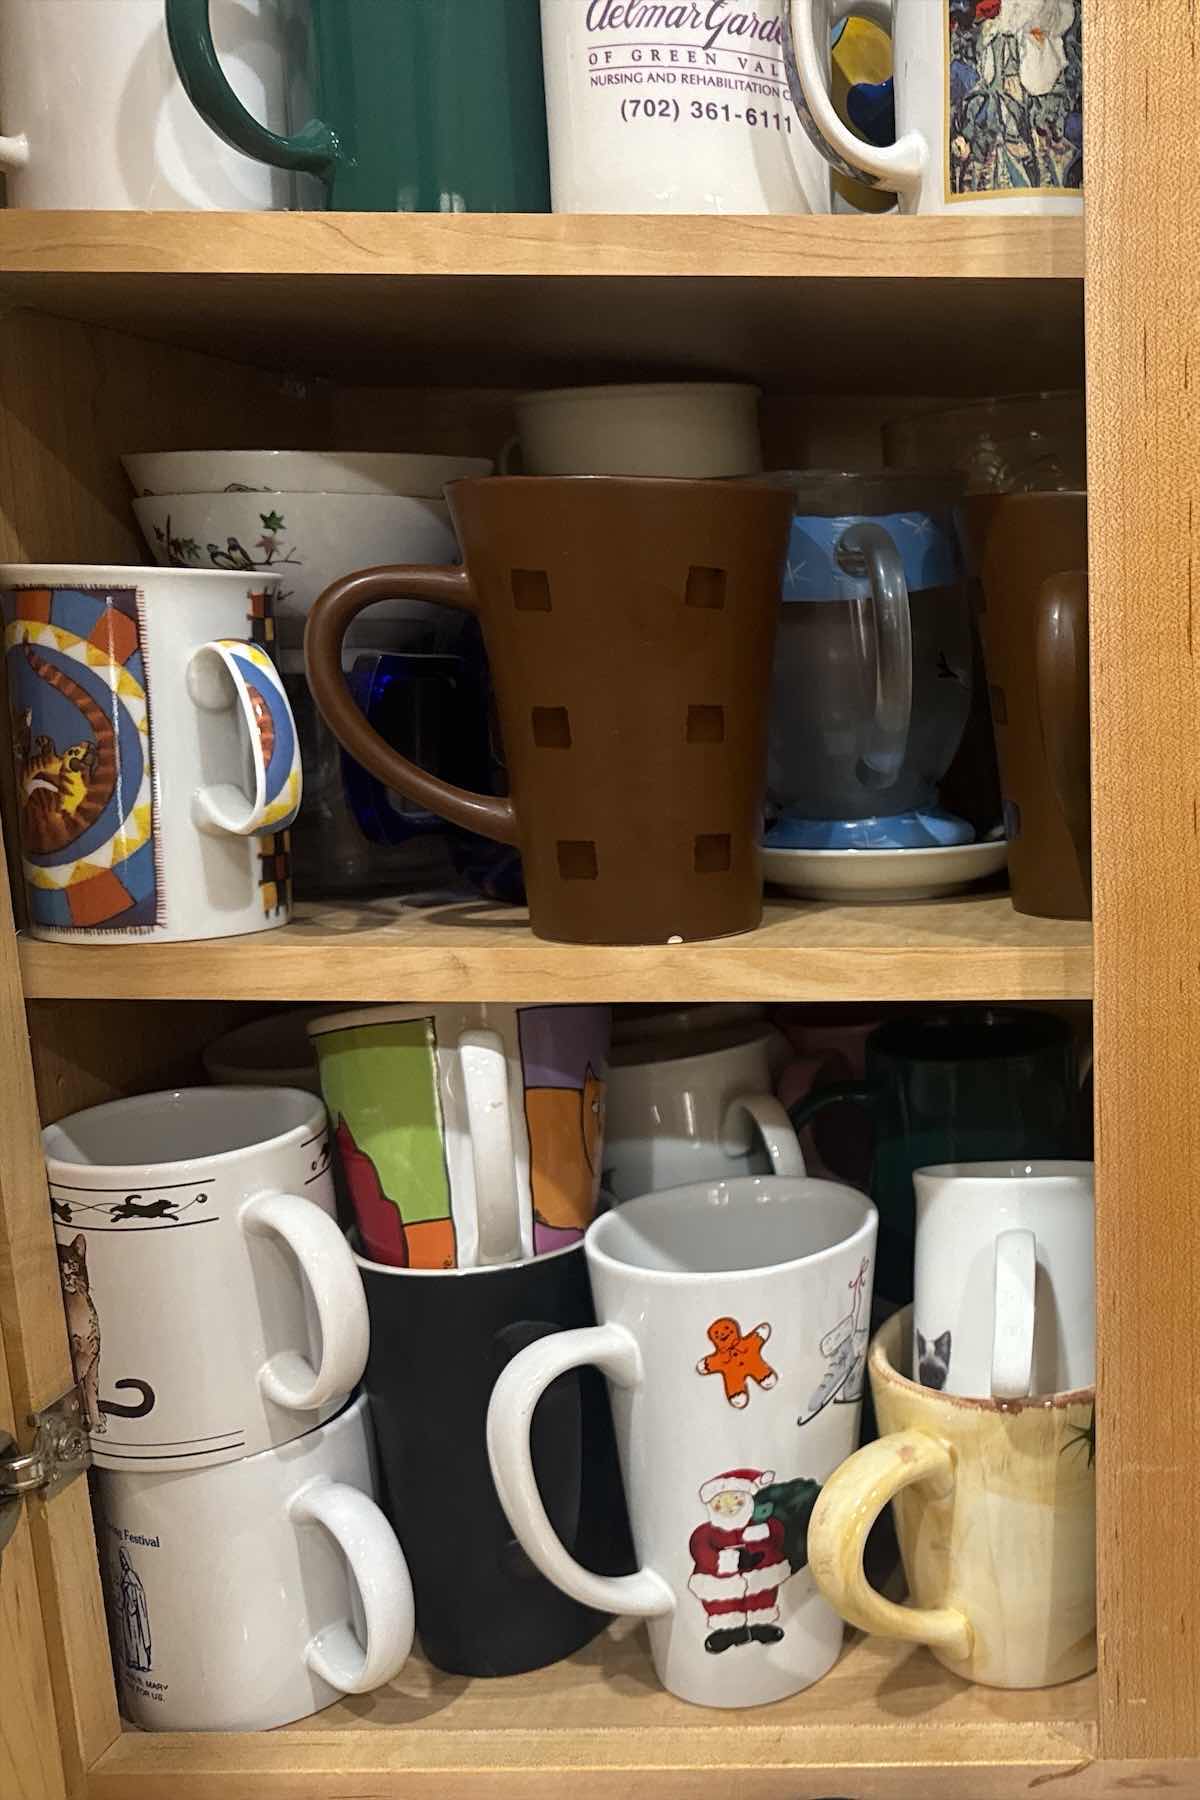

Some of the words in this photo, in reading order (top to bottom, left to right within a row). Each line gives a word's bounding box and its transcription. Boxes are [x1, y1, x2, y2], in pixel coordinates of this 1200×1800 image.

[588, 51, 613, 66] OF
[631, 49, 717, 66] GREEN
[590, 72, 644, 88] NURSING
[647, 72, 677, 85] AND
[680, 74, 780, 99] REHABILITATION
[620, 99, 680, 122] (702)
[690, 101, 792, 133] 361-6111
[124, 1529, 160, 1548] Festival
